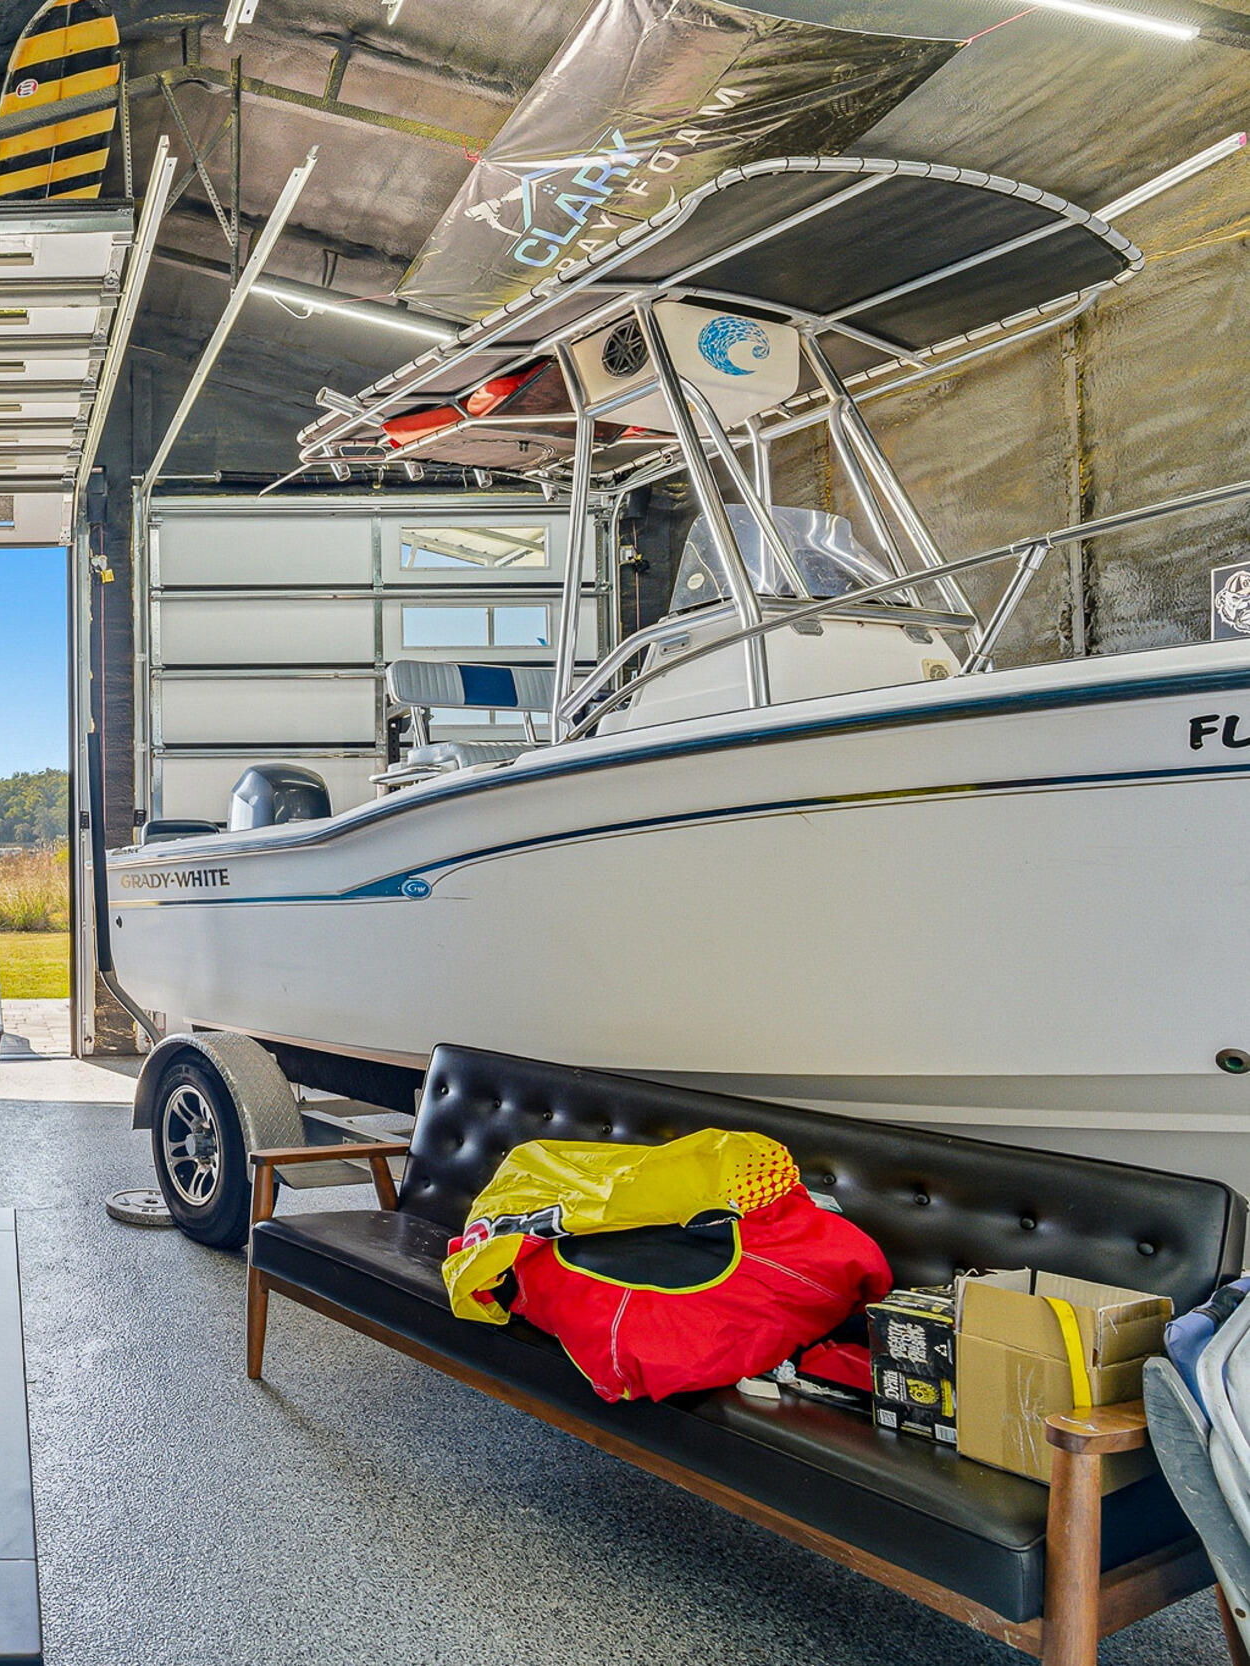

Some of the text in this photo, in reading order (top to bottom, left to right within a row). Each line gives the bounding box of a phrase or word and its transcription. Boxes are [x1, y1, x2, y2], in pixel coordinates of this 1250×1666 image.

[625, 87, 747, 197] FOAM
[513, 128, 660, 267] CLARK
[121, 868, 230, 889] GRADY-WHITE
